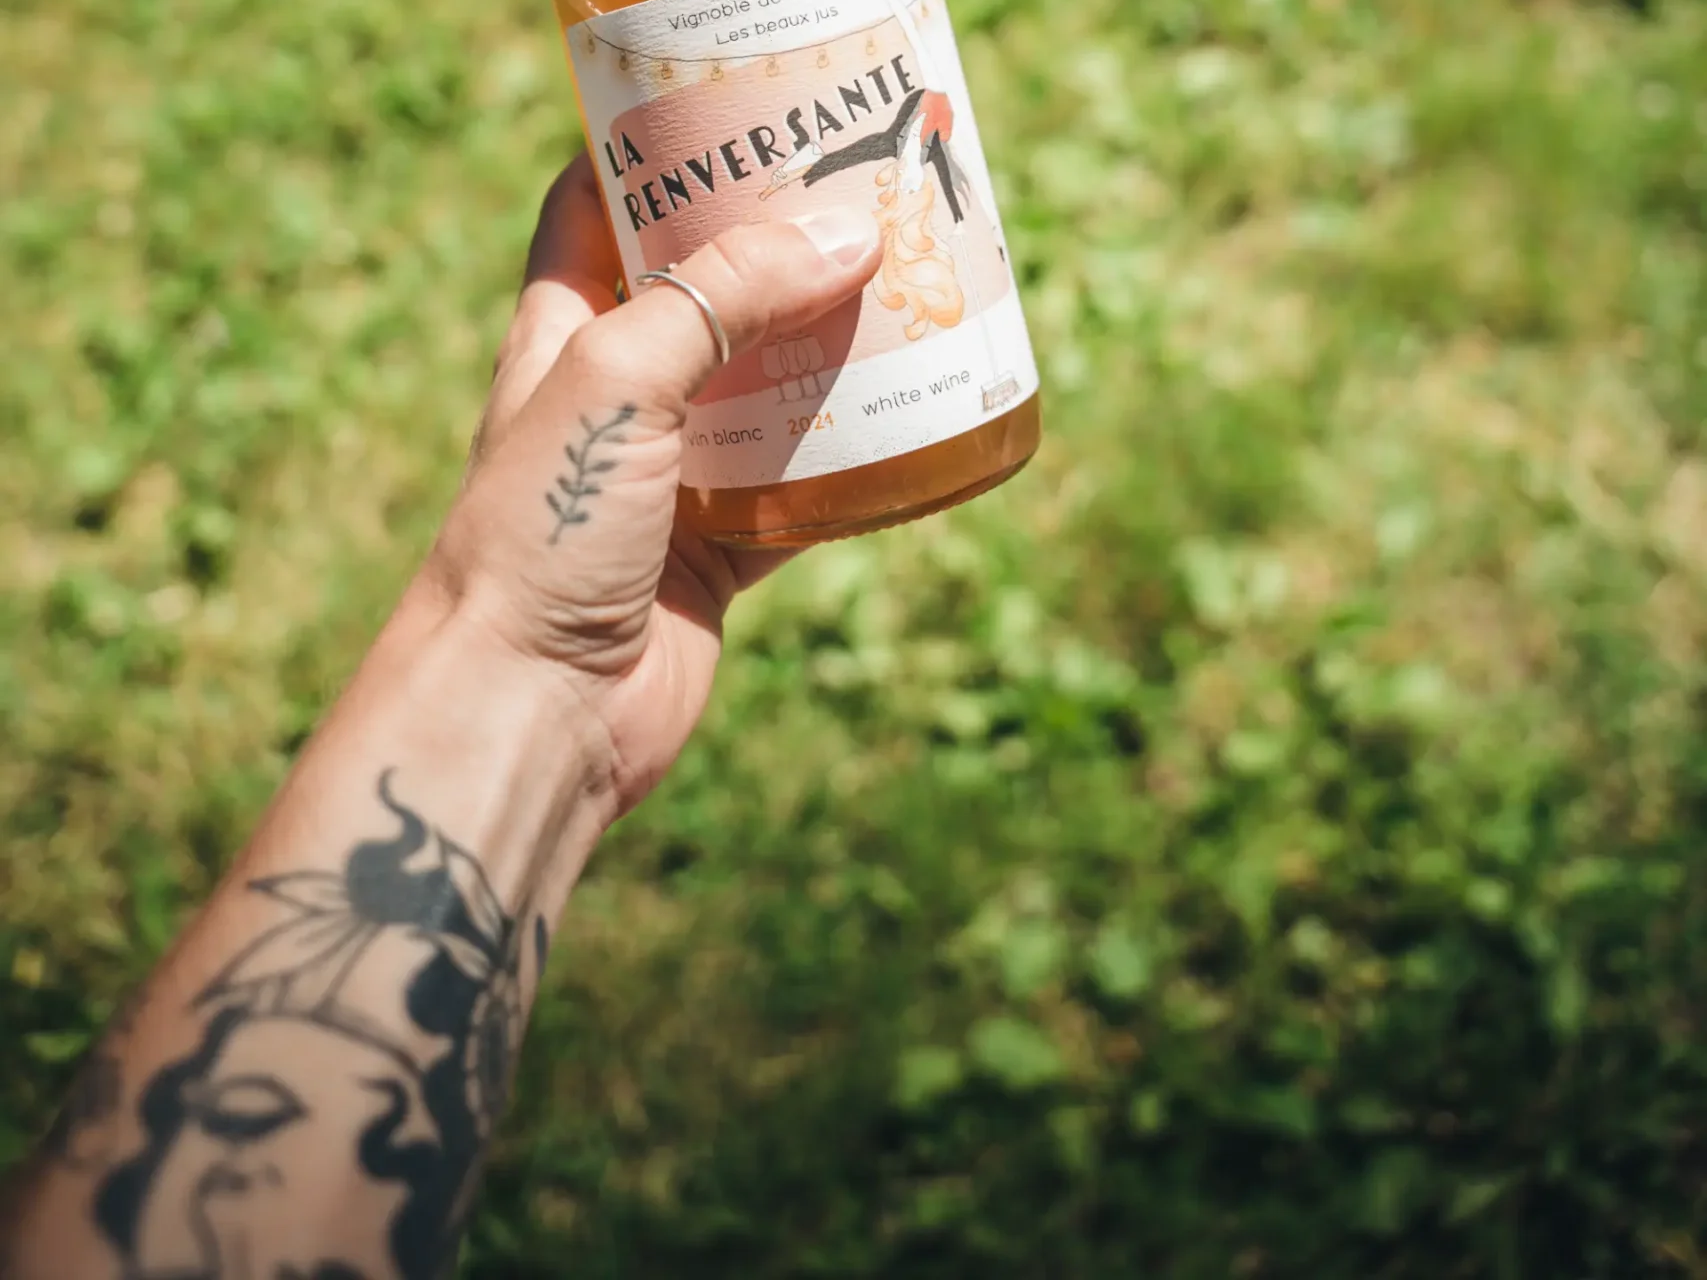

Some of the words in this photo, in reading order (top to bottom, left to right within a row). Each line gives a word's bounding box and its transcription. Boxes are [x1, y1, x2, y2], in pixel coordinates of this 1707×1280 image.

[668, 0, 751, 30] Vignoble
[715, 26, 750, 45] Les
[755, 15, 809, 35] beaux
[815, 4, 839, 23] jus
[604, 131, 645, 178] LA
[623, 54, 916, 232] RENVERSANTE
[687, 431, 709, 447] vin
[712, 427, 764, 446] blanc
[861, 388, 922, 417] white
[928, 369, 971, 396] wine
